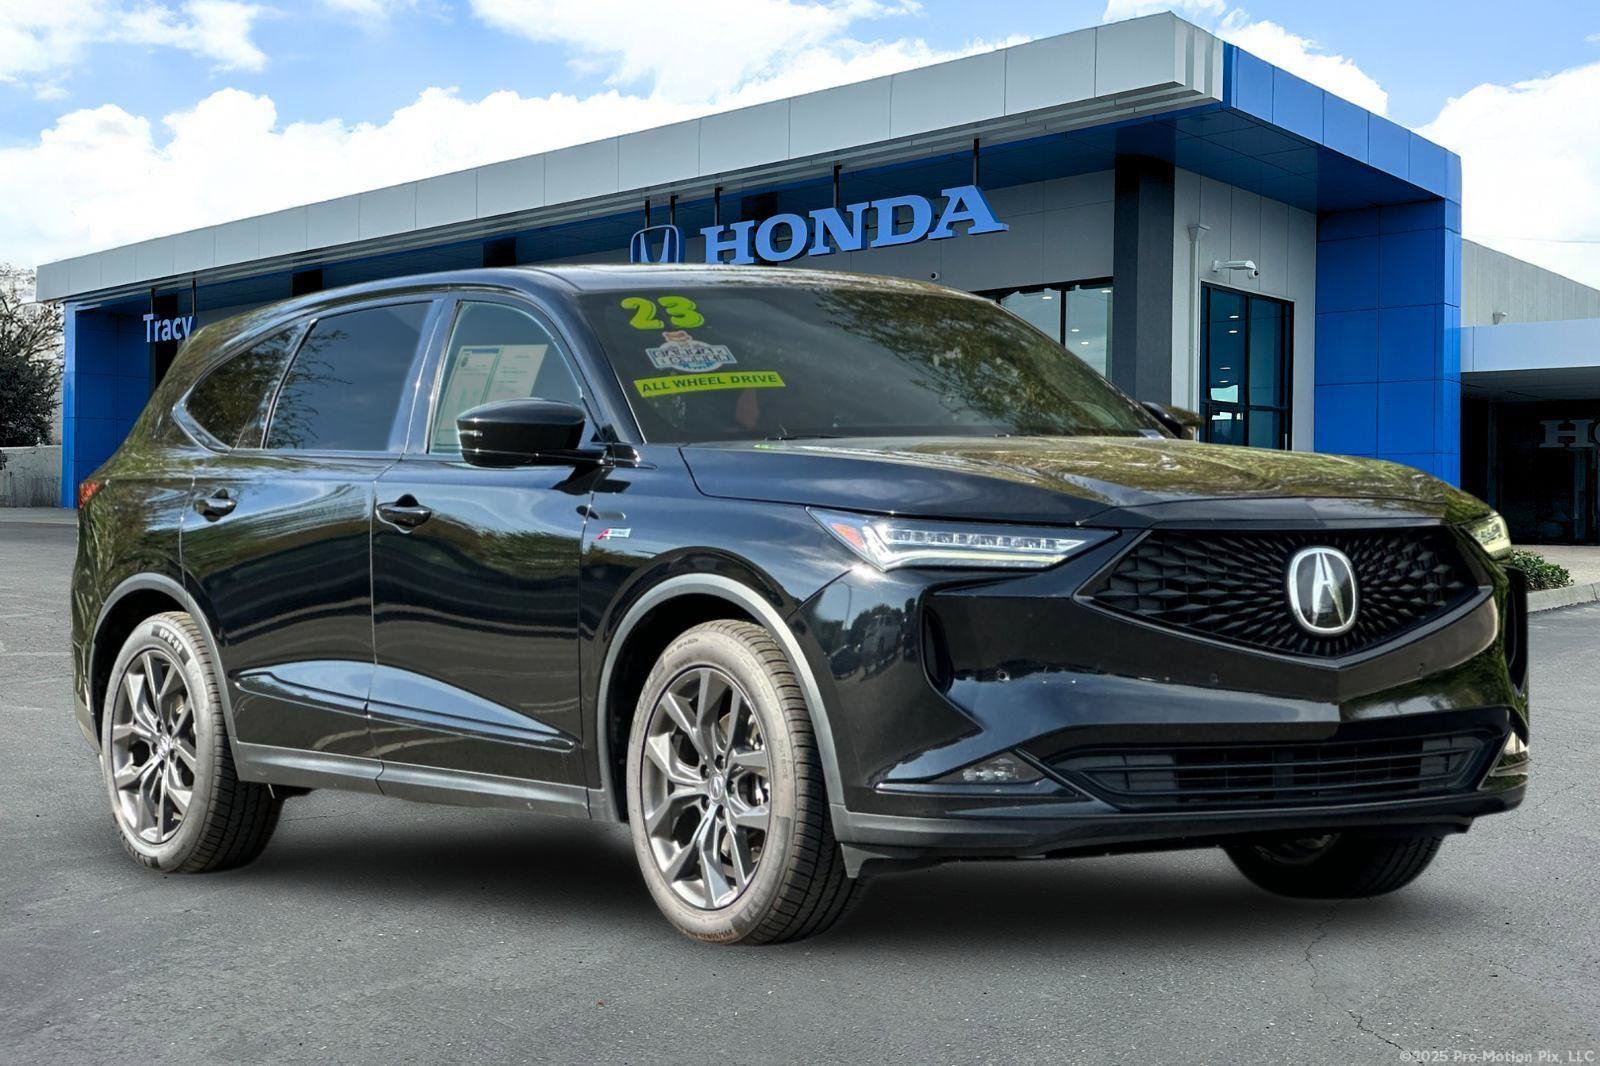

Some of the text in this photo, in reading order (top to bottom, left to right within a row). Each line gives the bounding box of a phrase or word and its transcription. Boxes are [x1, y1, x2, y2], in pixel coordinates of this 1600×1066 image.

[701, 184, 1009, 265] HONDA
[143, 313, 193, 343] Tracy
[620, 296, 705, 330] 23
[642, 374, 778, 392] ALL WHEEL DRIVE
